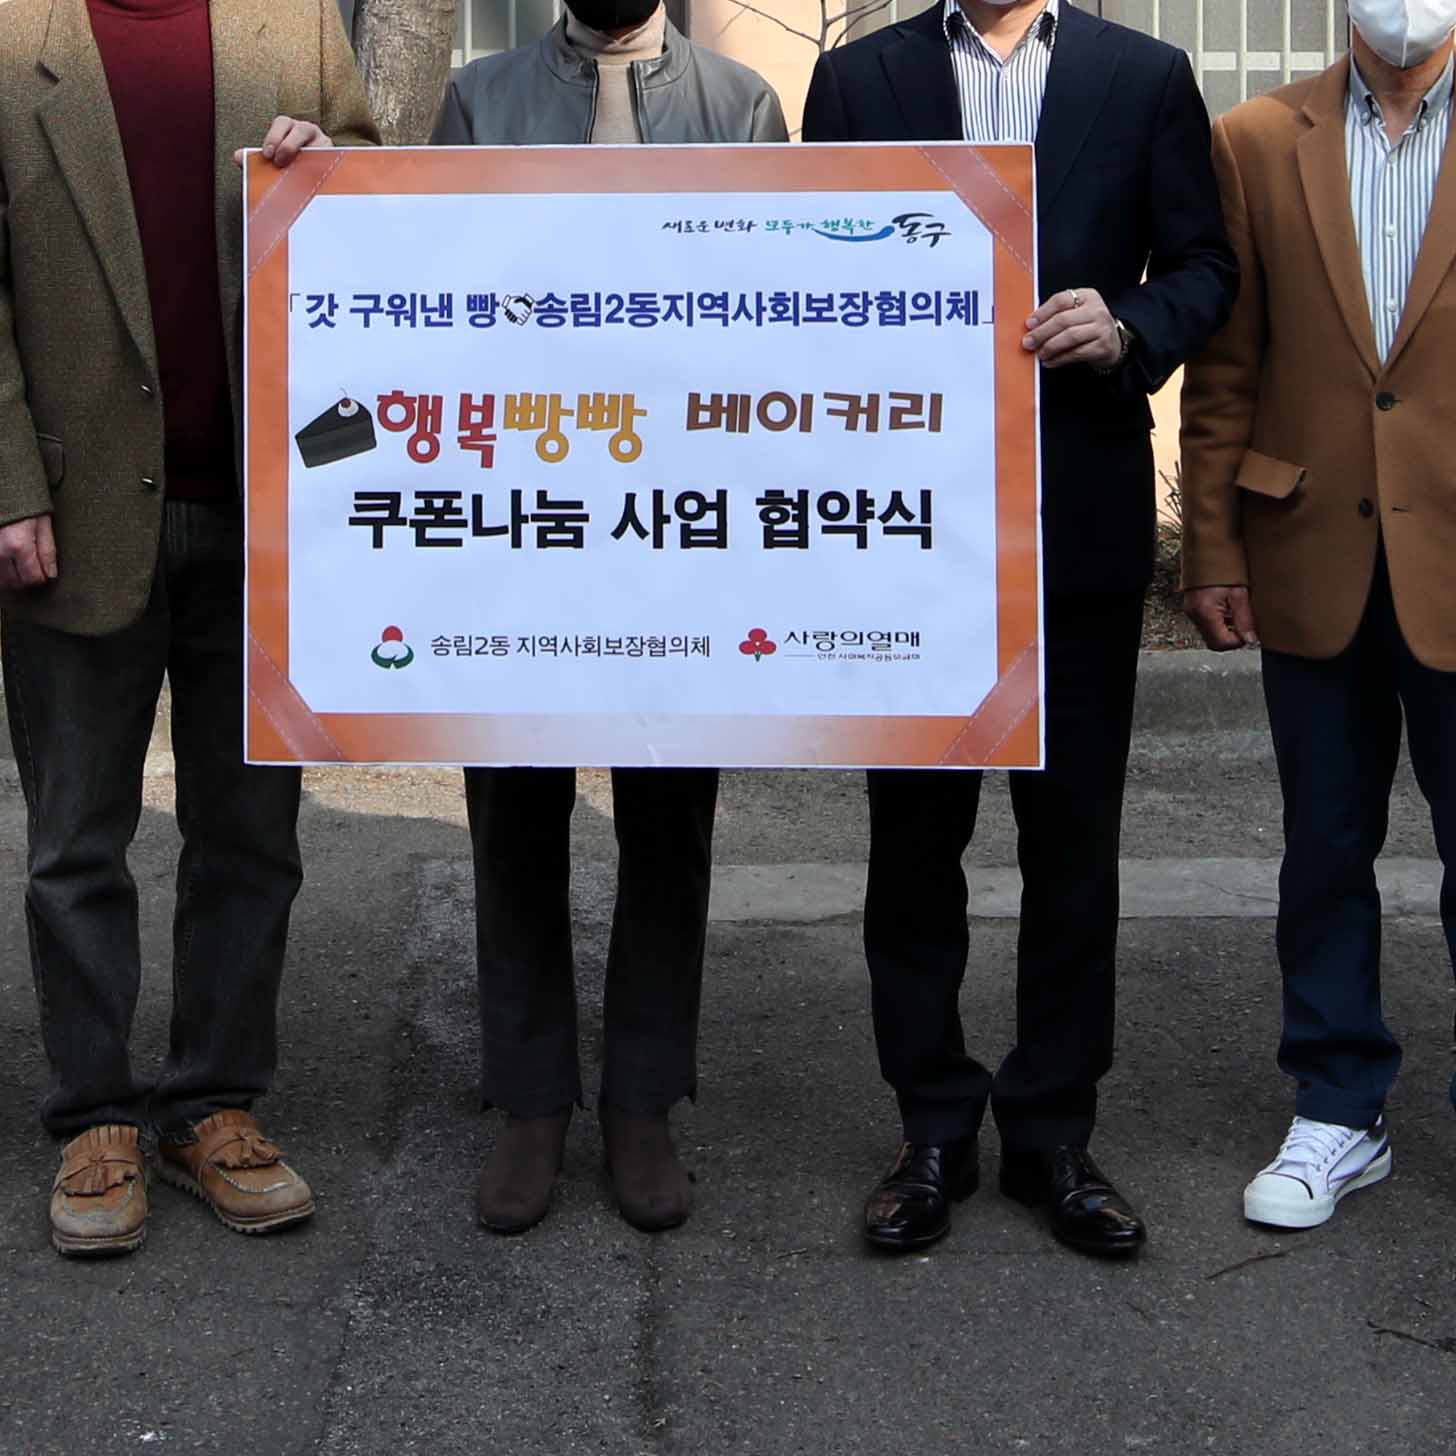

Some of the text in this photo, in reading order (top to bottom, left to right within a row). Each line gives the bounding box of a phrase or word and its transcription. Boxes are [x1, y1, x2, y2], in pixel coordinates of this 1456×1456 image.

[891, 212, 952, 249] 동구
[349, 292, 455, 329] 구워낸
[465, 292, 501, 329] 빵
[376, 389, 945, 470] 행복빵빵 베이커리
[347, 488, 934, 550] 쿠폰나눔 사업 협약식
[430, 634, 712, 658] 송림2동 지역사회보장협의체
[783, 630, 922, 653] 사랑의열매
